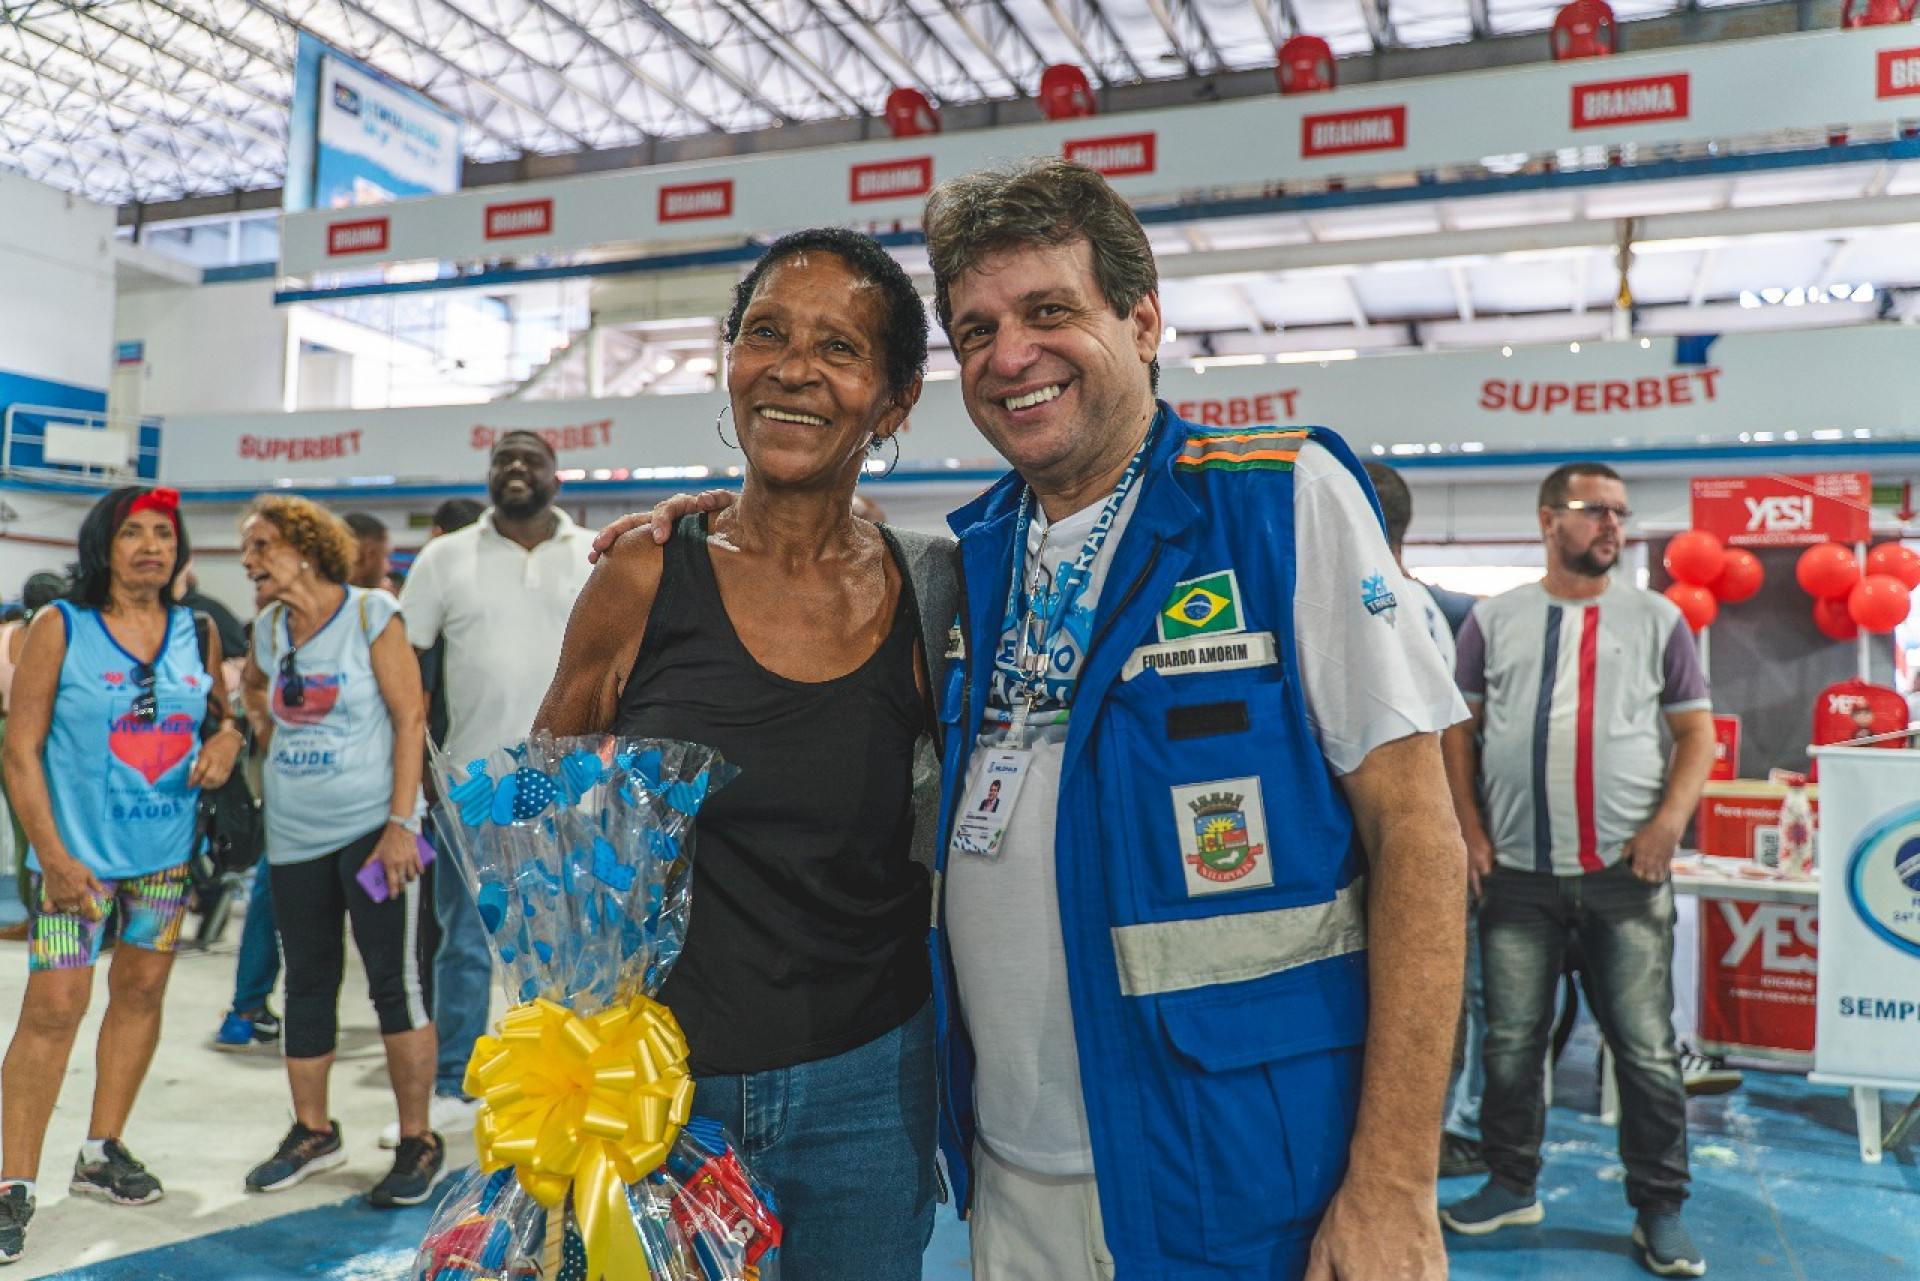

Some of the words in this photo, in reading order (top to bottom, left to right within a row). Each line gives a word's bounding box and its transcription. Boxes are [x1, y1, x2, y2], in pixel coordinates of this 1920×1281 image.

[1583, 84, 1676, 119] BRAHMA
[1311, 116, 1394, 149] BRAHMA
[1174, 388, 1300, 426] ERBET
[1479, 366, 1721, 414] SUPERBET
[238, 430, 364, 462] SUPERBET
[469, 418, 612, 452] SRBET
[1744, 495, 1813, 531] YES!
[1142, 649, 1196, 669] EDUARDO
[1200, 643, 1248, 664] AMORIM
[1839, 996, 1920, 1021] SEMP
